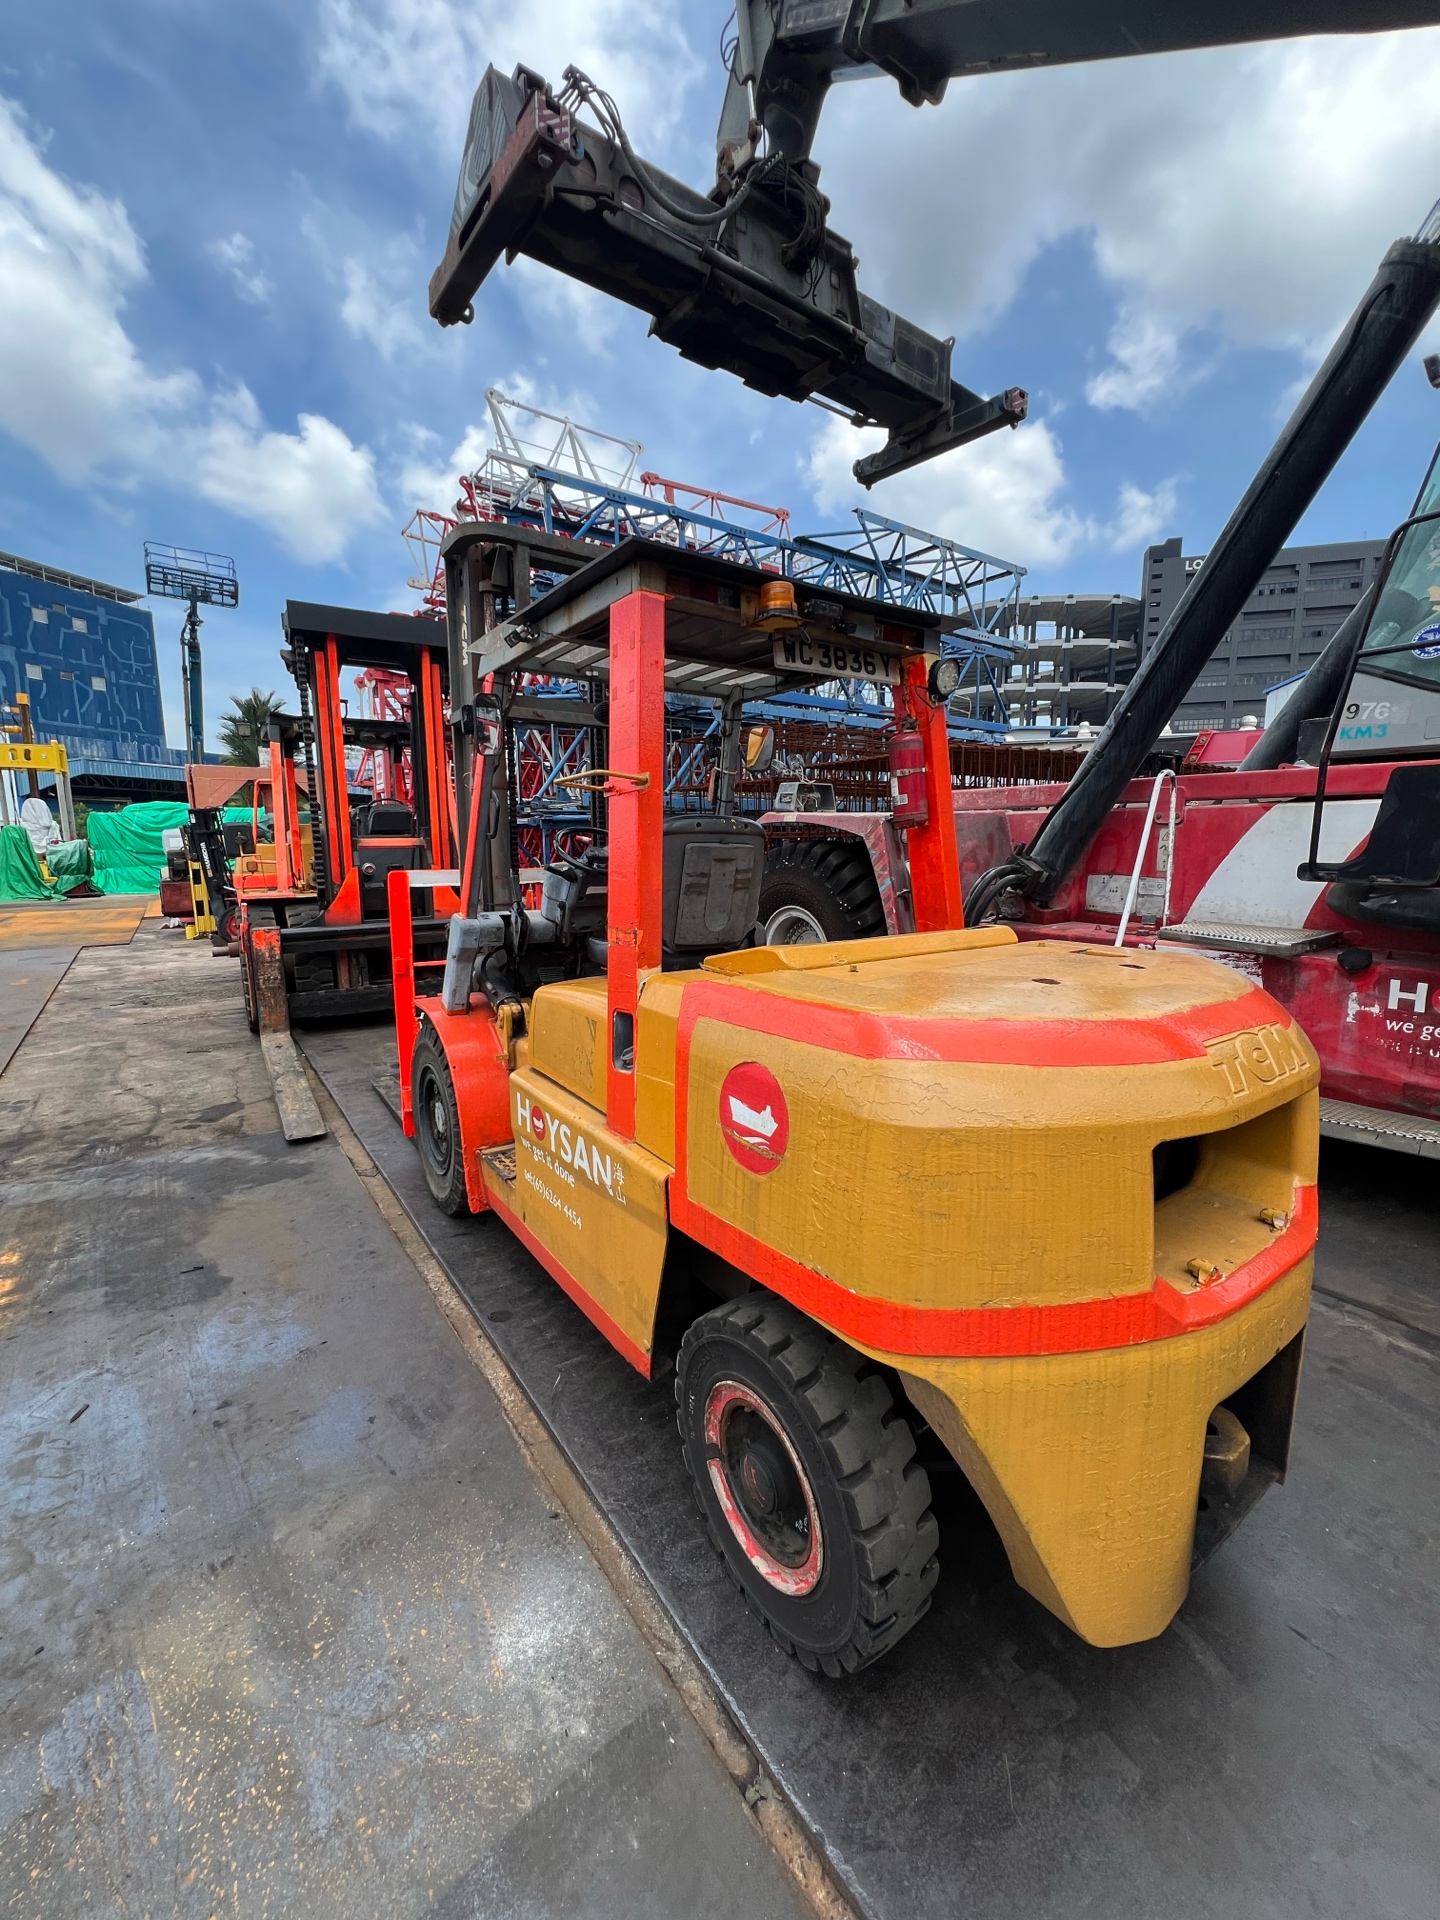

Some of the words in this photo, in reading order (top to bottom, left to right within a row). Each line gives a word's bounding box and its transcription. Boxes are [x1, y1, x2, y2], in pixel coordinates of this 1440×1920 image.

[460, 604, 468, 666] TCM
[1387, 979, 1440, 1014] H
[1386, 1019, 1414, 1034] we
[1203, 1021, 1310, 1099] TCM
[520, 1136, 532, 1152] we
[532, 1145, 546, 1164] get
[545, 1151, 553, 1170] it
[554, 1159, 576, 1188] done
[563, 1204, 583, 1231] 4454
